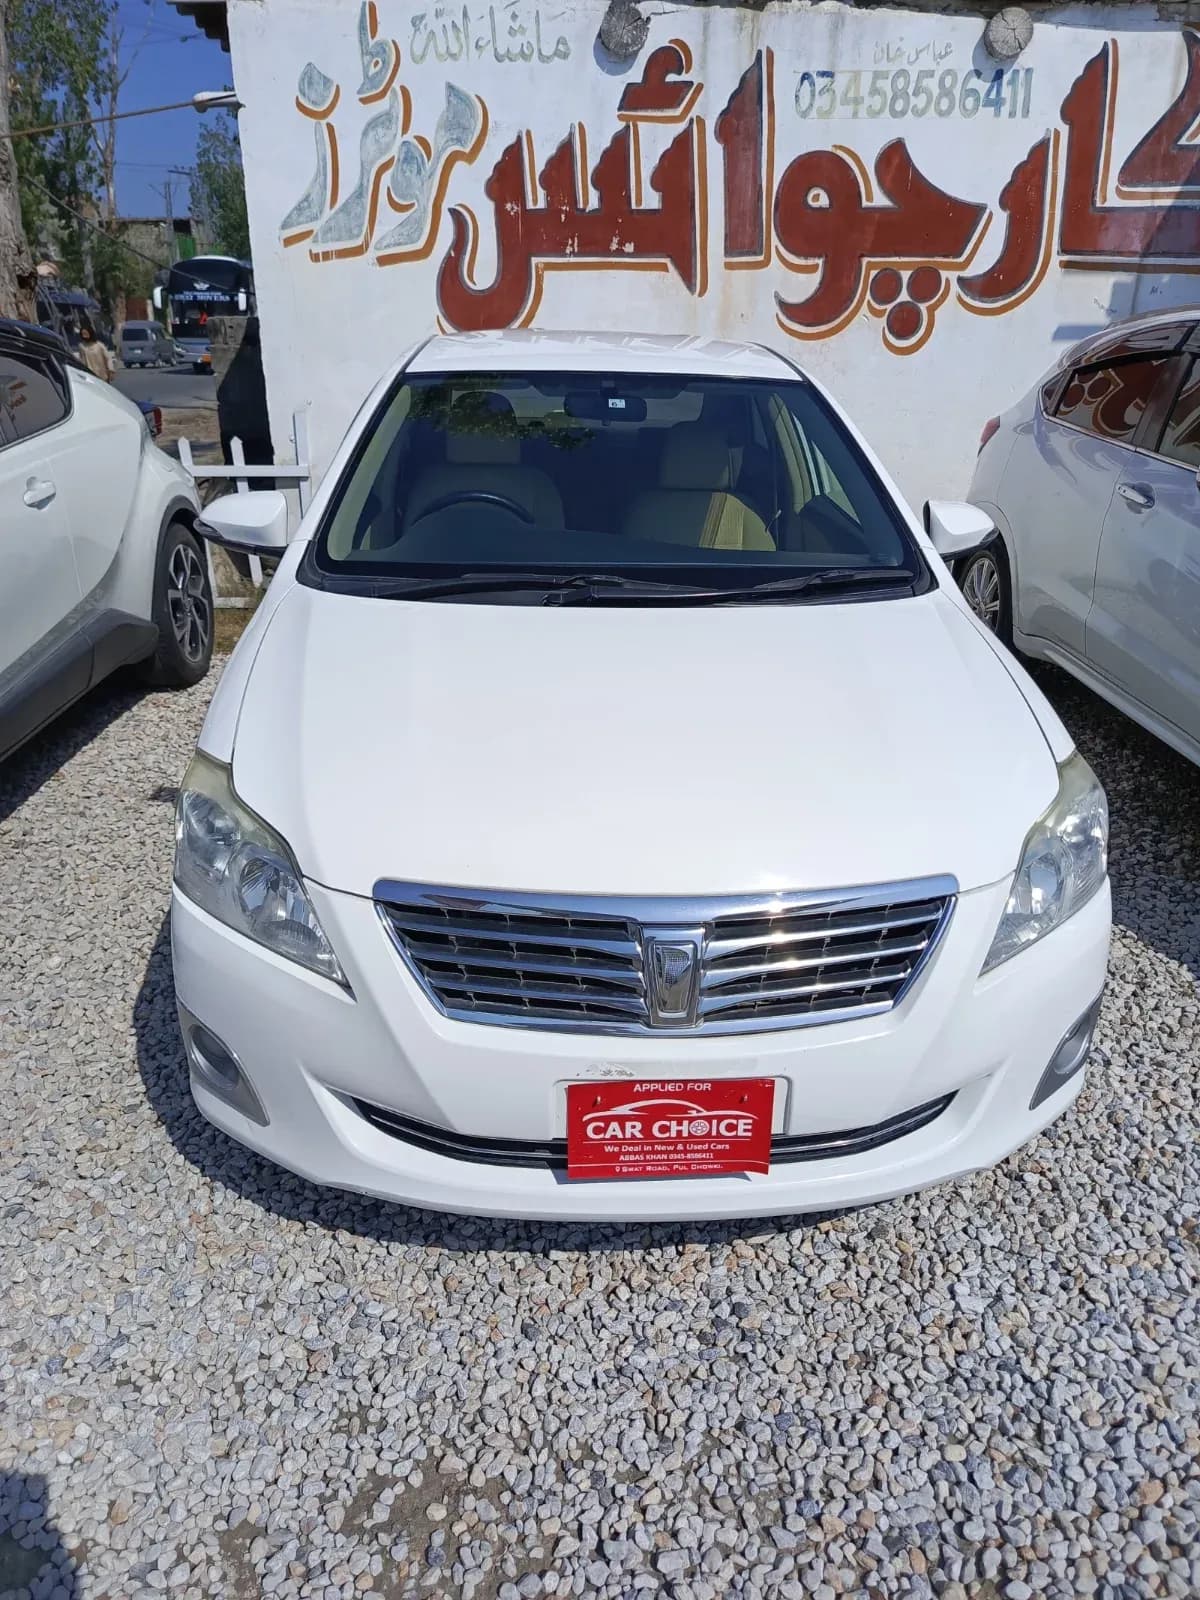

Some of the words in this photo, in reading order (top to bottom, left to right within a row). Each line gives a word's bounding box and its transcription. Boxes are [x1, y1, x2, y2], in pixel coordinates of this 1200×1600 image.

[872, 36, 905, 65] خان
[907, 39, 954, 67] عباس
[794, 67, 1034, 120] 03458586411
[633, 1083, 684, 1093] APPLIED
[687, 1082, 712, 1091] FOR
[586, 1121, 644, 1139] CAR
[652, 1119, 753, 1138] CHOICE
[603, 1144, 620, 1153] We
[621, 1144, 642, 1152] Deal
[710, 1142, 730, 1150] Cars
[645, 1153, 668, 1161] KHAN
